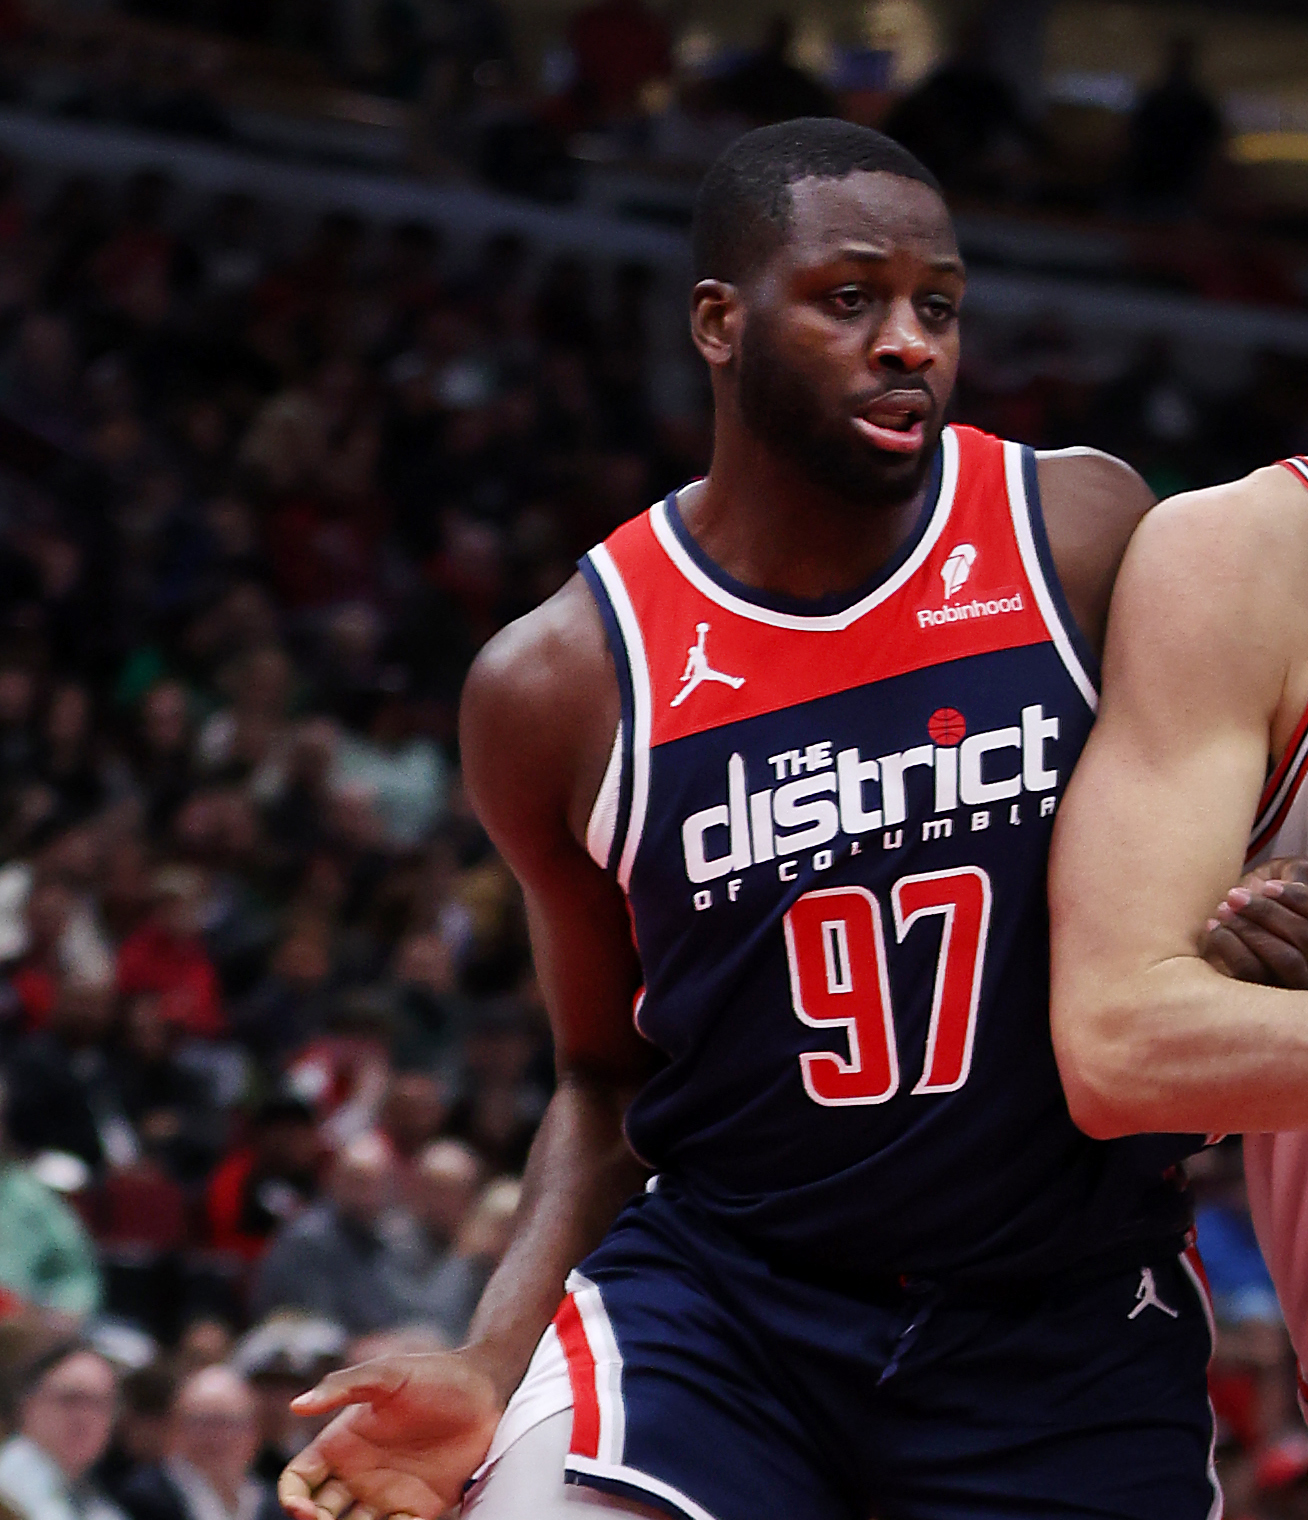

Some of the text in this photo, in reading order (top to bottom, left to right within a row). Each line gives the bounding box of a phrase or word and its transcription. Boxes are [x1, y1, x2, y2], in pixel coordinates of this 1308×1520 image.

[917, 593, 1024, 628] Robinhood
[768, 741, 834, 780] THE
[682, 704, 1059, 884] district
[694, 877, 743, 911] OF
[783, 865, 993, 1107] 97
